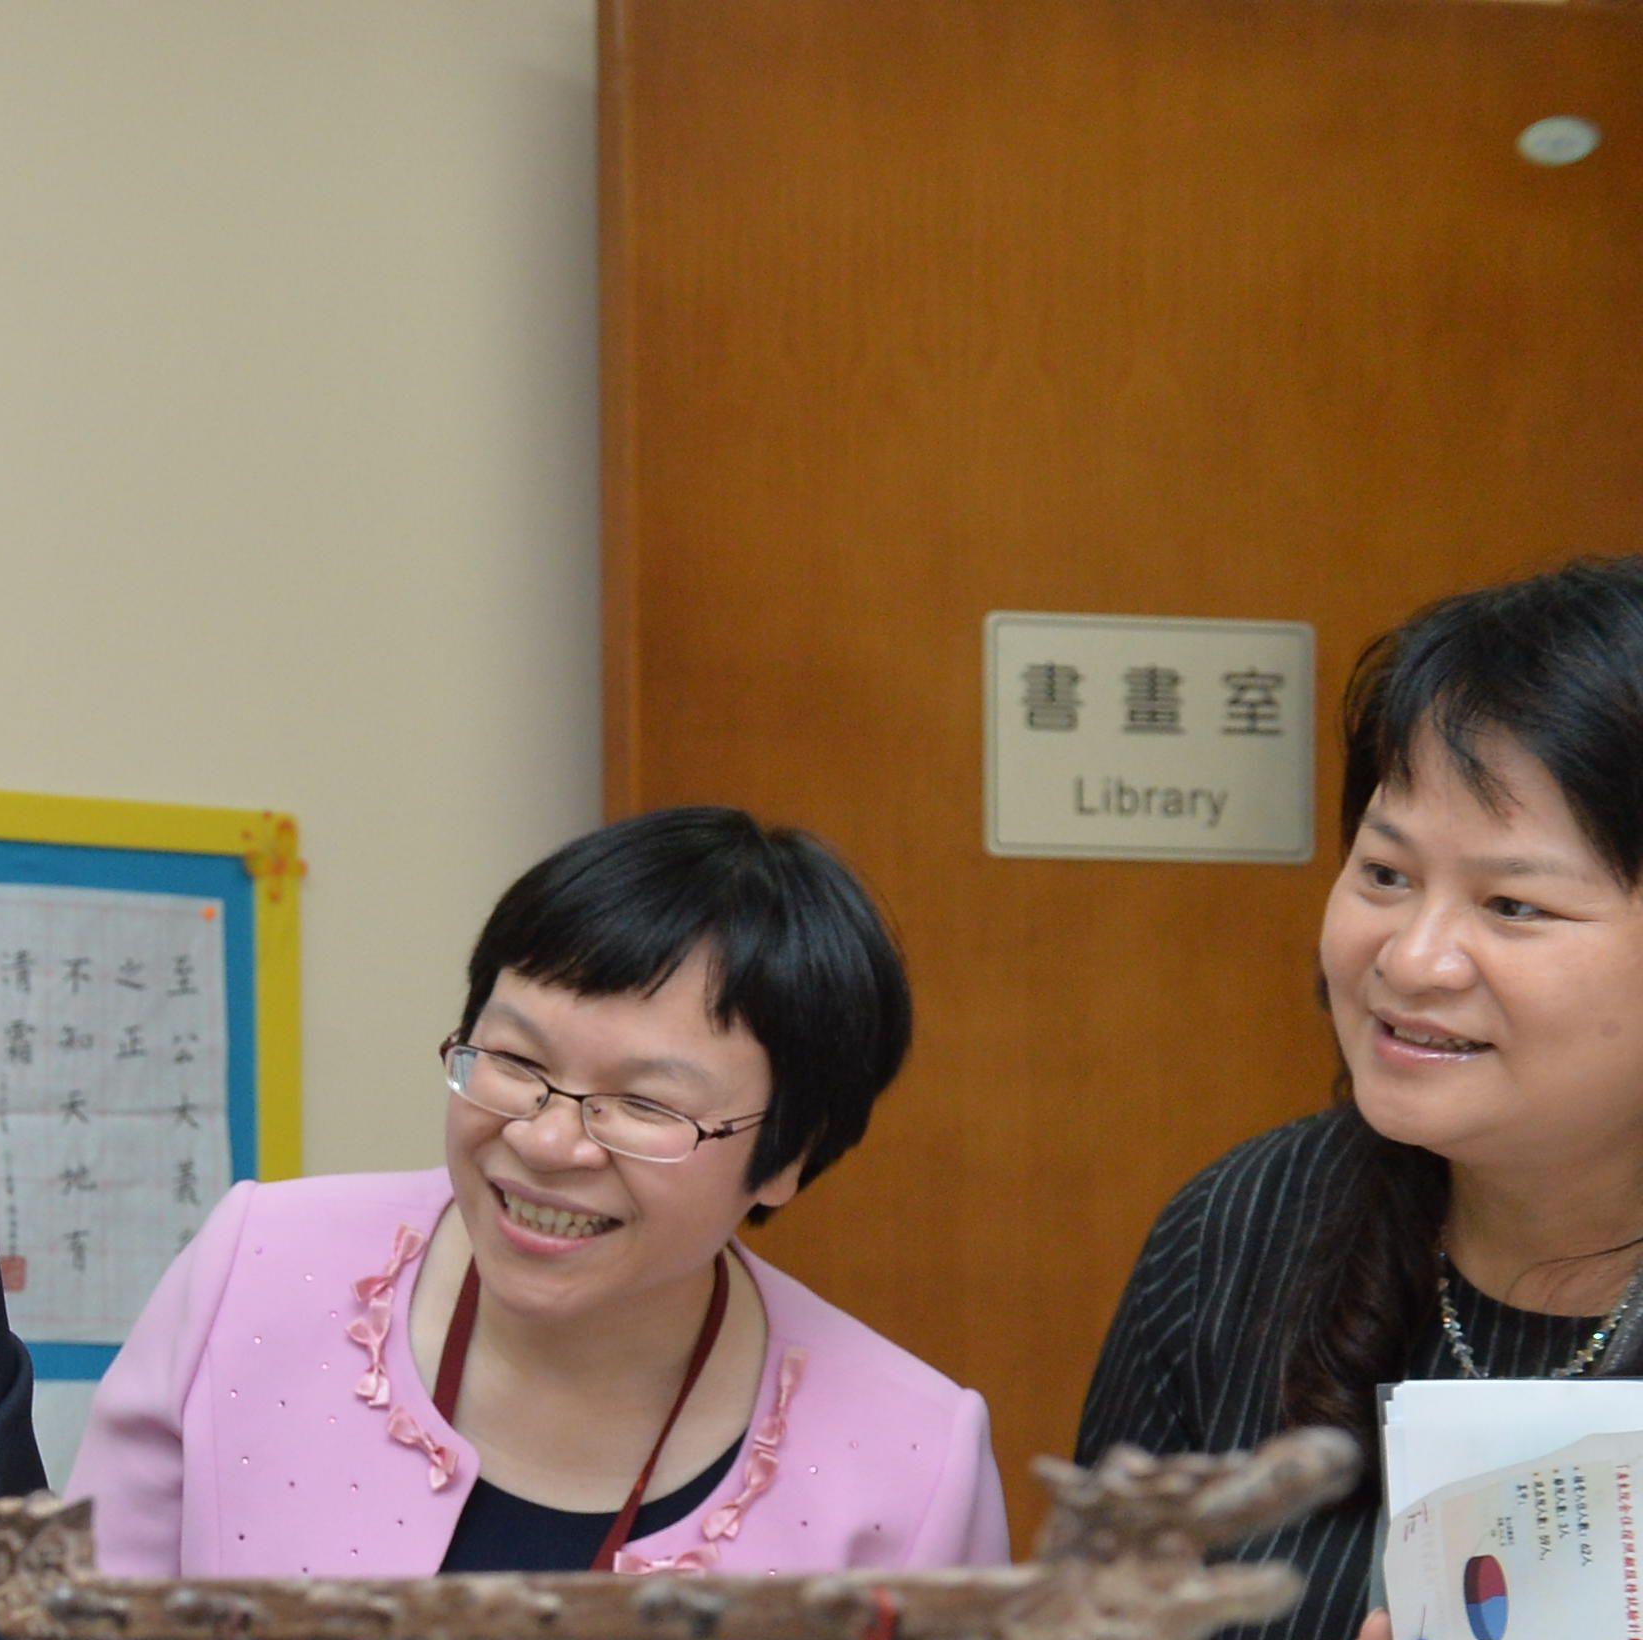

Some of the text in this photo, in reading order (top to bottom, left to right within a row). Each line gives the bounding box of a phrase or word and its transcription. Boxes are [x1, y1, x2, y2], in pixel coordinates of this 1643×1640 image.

[1021, 660, 1284, 738] 書畫室
[1073, 775, 1229, 828] Library
